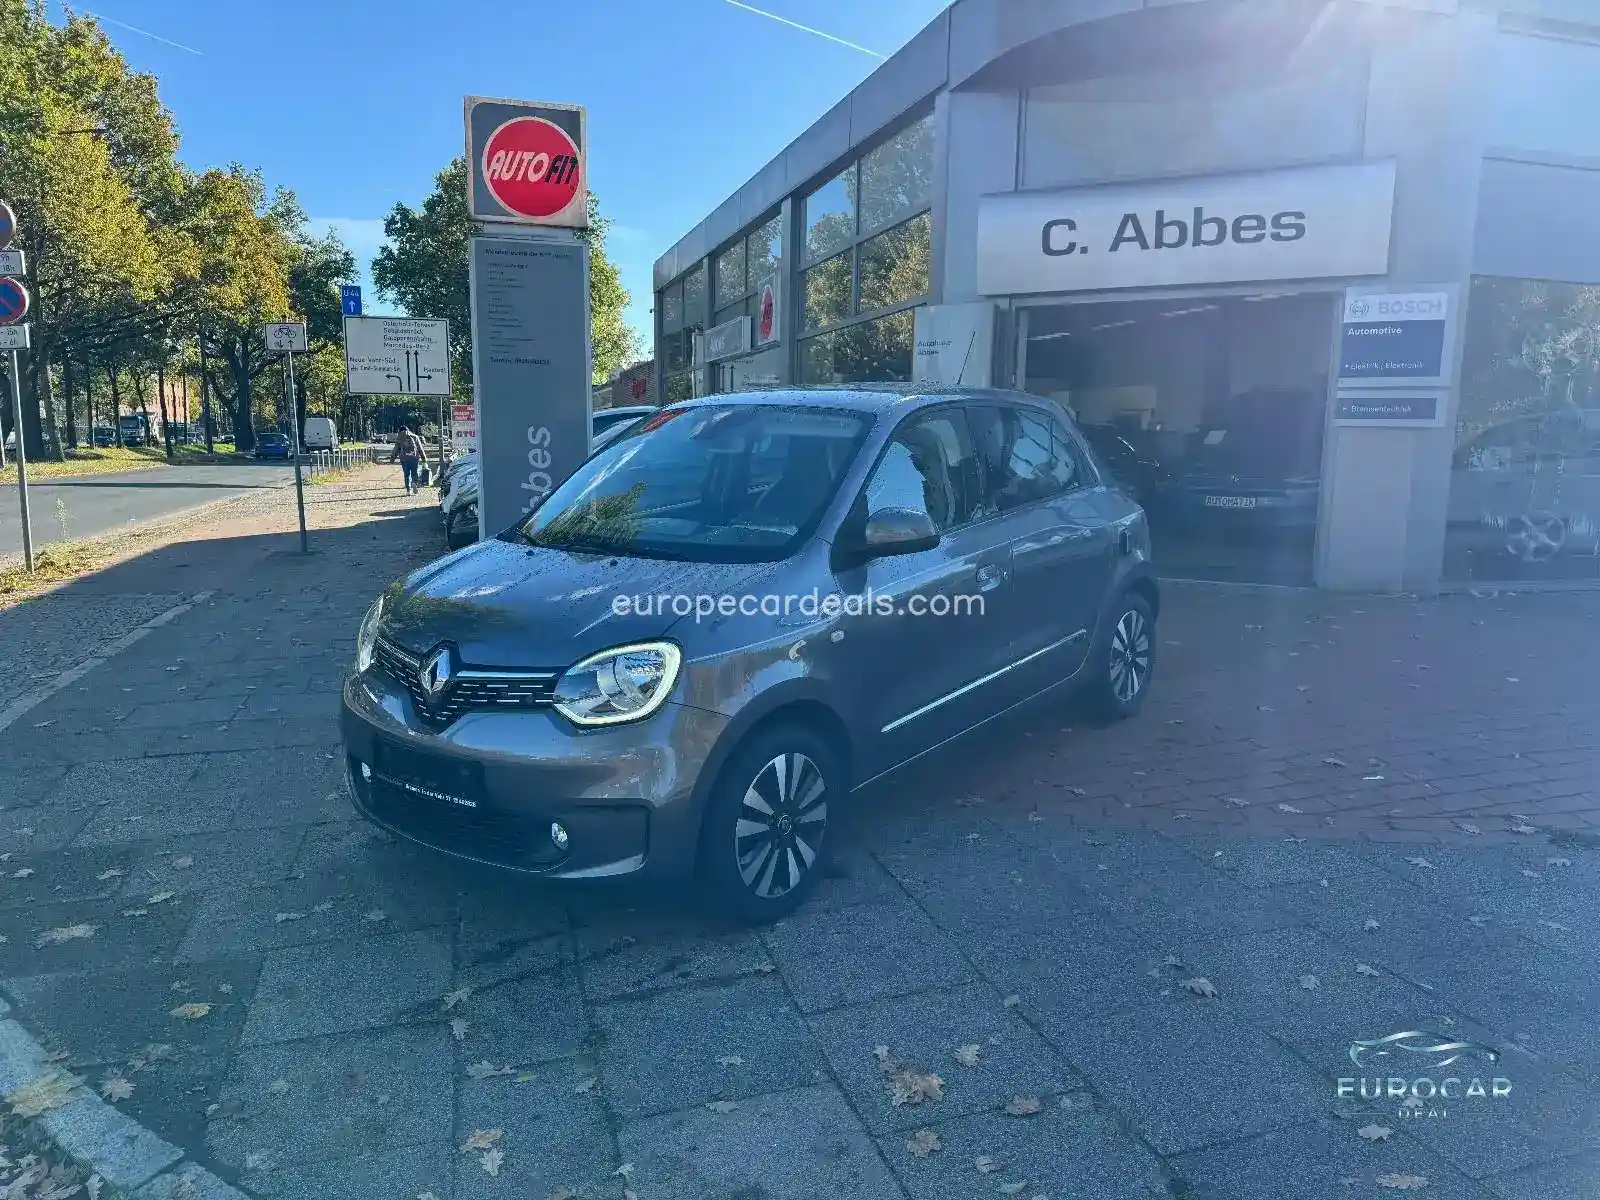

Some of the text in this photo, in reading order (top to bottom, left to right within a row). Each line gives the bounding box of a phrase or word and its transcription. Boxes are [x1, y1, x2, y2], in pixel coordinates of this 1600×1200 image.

[1041, 206, 1305, 257] C. Abbes
[1378, 301, 1442, 315] BOSCH
[1347, 327, 1402, 336] Automotive
